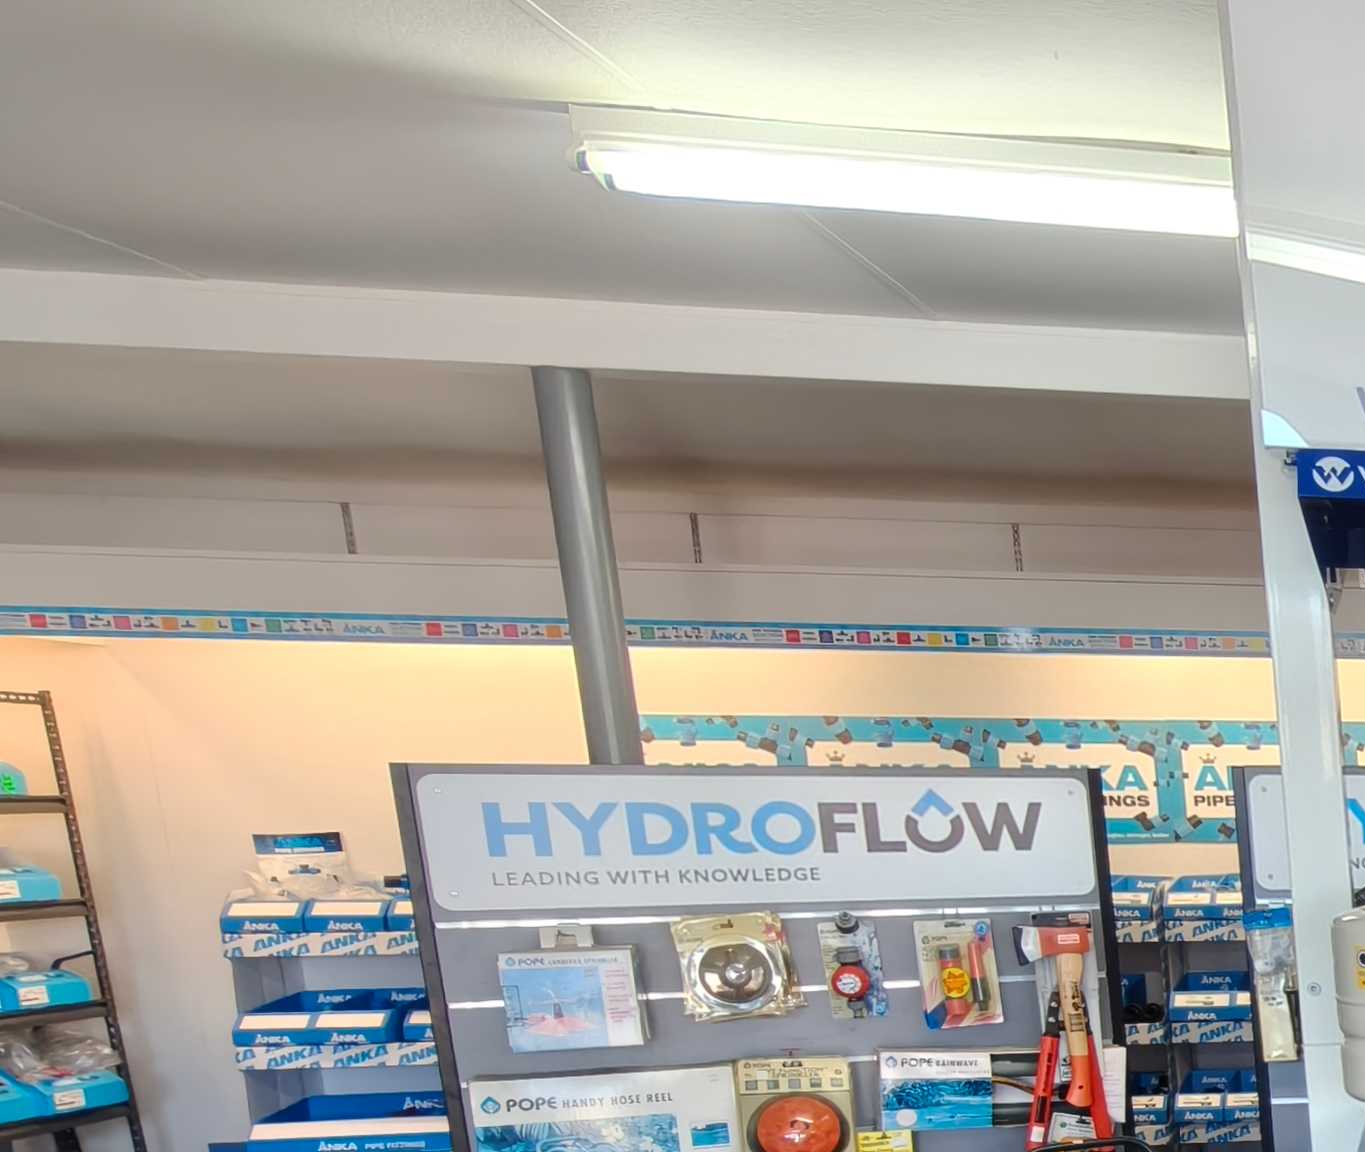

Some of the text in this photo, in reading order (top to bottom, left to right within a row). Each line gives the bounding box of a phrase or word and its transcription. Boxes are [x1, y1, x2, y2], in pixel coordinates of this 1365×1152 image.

[1100, 766, 1148, 791] KA
[1102, 795, 1150, 807] INGS
[481, 788, 1042, 858] HYDROFLOW
[492, 866, 821, 886] LEADING WITH KNOWLEDGE
[901, 1057, 934, 1069] POPE
[506, 1092, 673, 1112] POPE HANDY HOSE REEL
